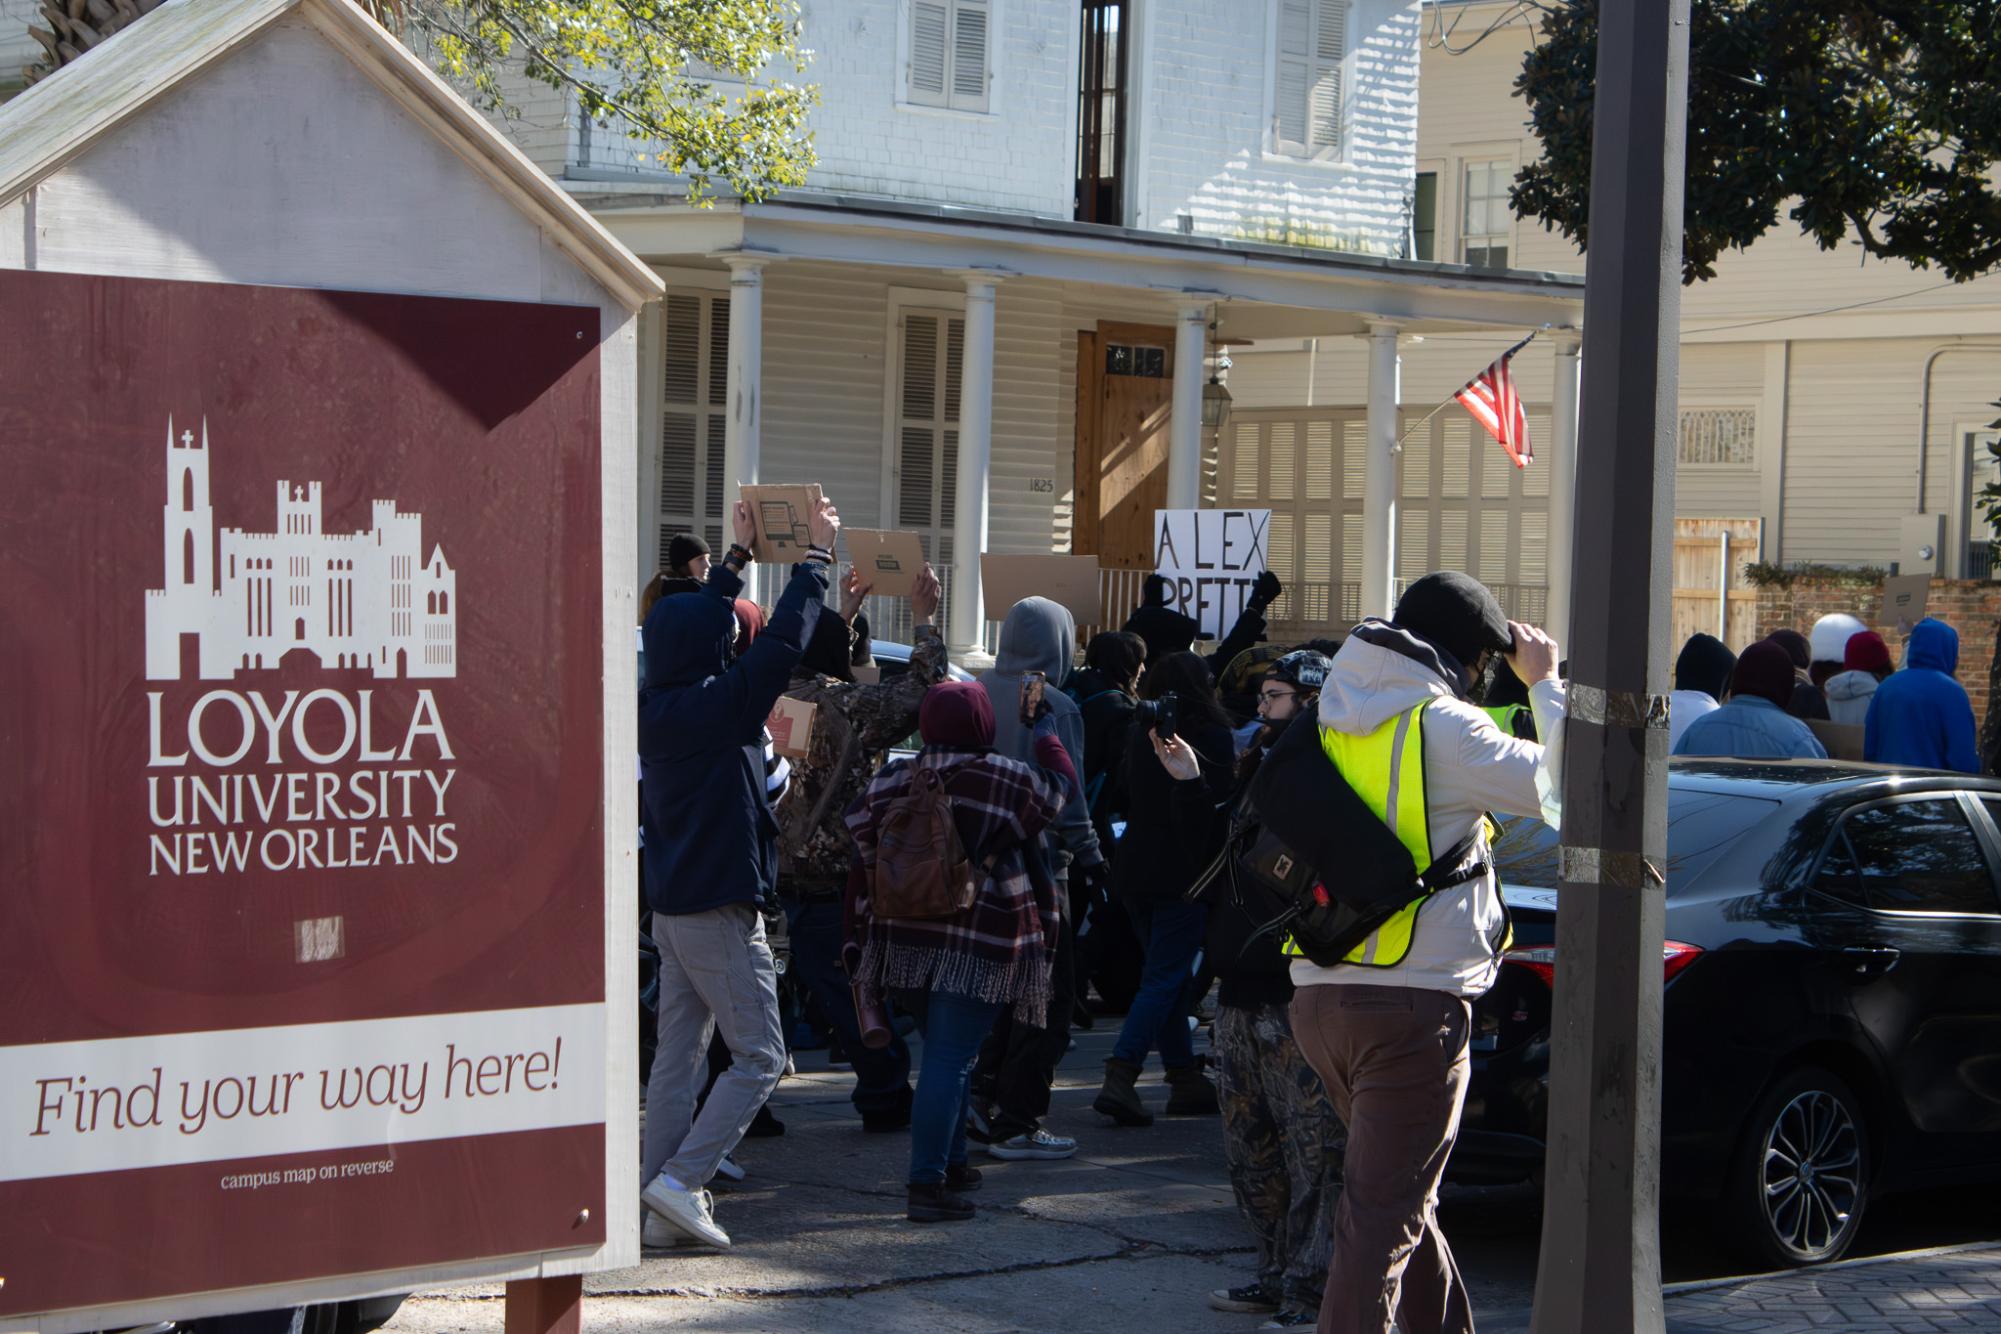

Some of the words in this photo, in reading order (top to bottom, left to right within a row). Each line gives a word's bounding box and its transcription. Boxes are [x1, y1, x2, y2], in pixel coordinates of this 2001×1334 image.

[1030, 478, 1054, 493] 1825
[1155, 510, 1270, 573] ALEX
[1160, 576, 1260, 641] PRETT
[146, 688, 456, 767] LOYOLA
[147, 768, 456, 827] UNIVERSITY
[149, 830, 254, 876] NEW
[260, 822, 459, 871] ORLEANS
[29, 1066, 164, 1137] Find
[178, 1070, 305, 1135] your
[319, 1061, 429, 1115] way
[444, 1036, 562, 1099] here!
[220, 1171, 281, 1190] campus
[283, 1167, 317, 1185] map
[319, 1165, 338, 1180] on
[340, 1159, 395, 1177] reverse
